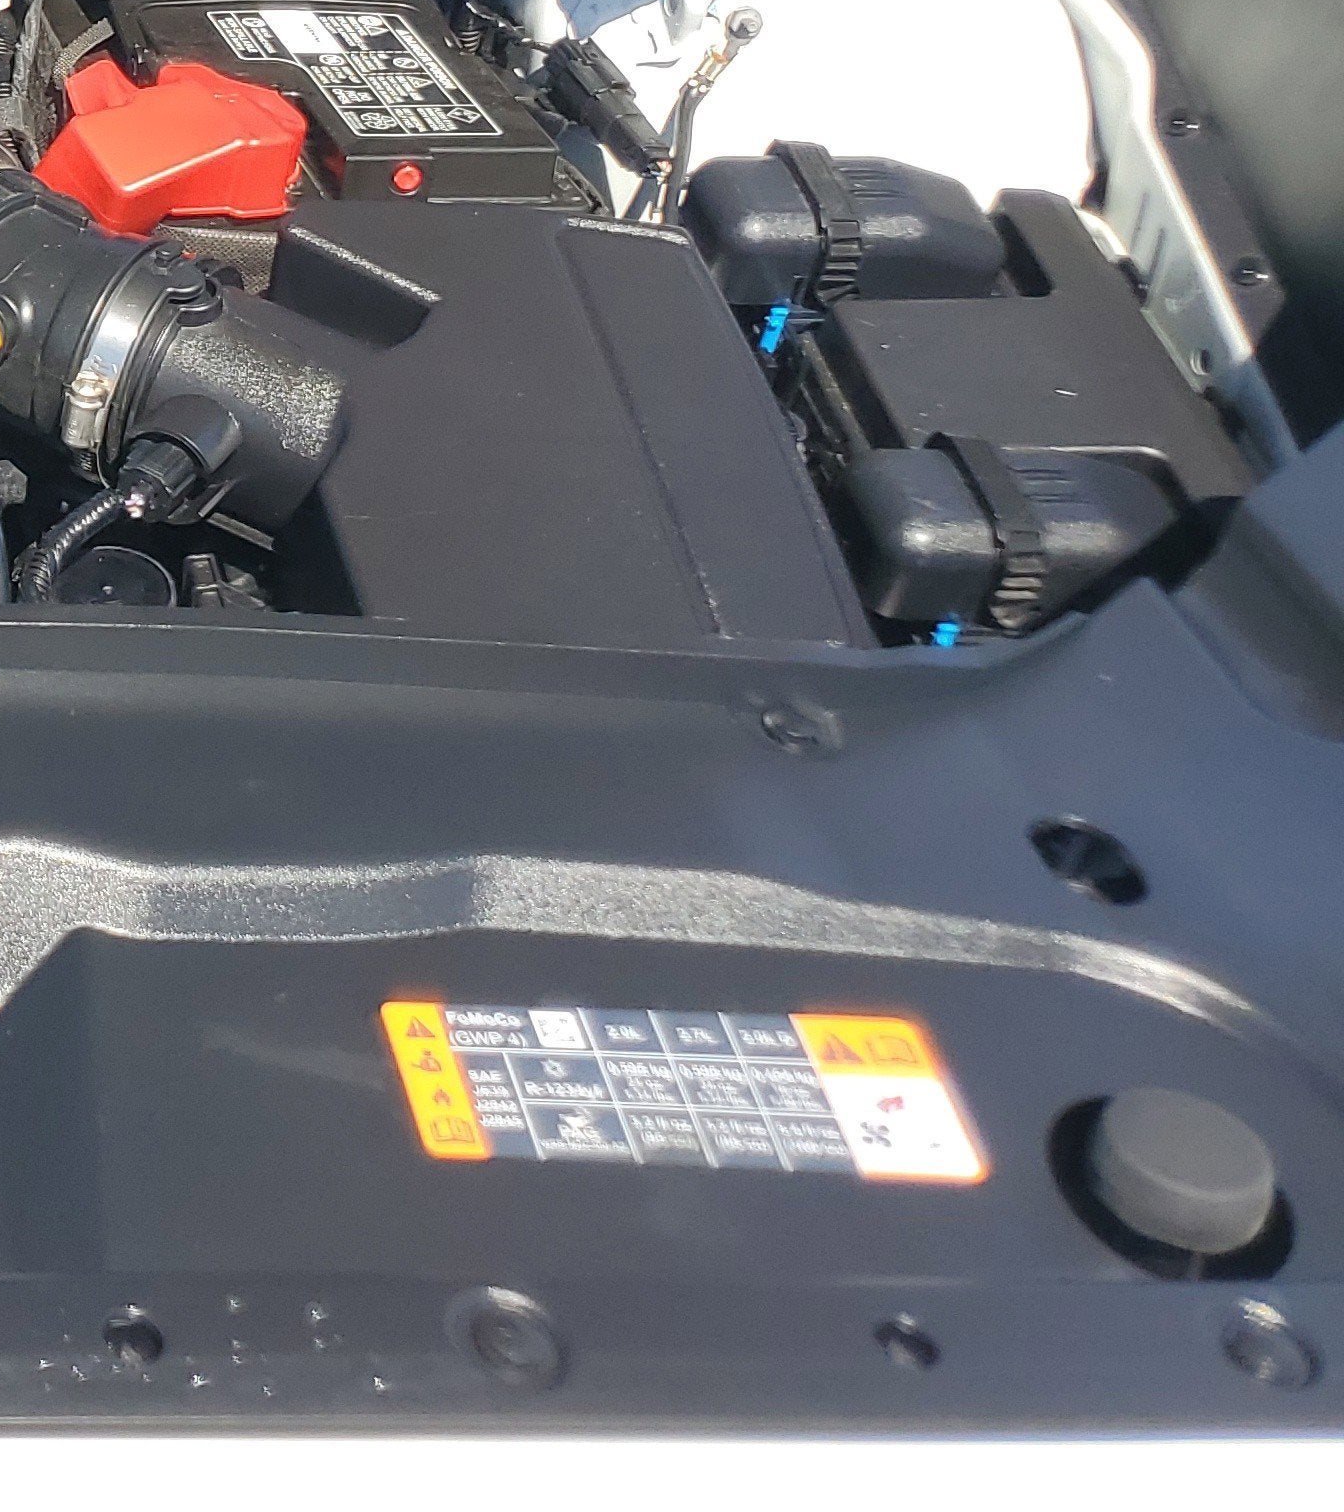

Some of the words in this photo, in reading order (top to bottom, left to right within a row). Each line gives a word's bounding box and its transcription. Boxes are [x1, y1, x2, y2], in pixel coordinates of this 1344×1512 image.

[445, 1010, 522, 1027] FoMoCo
[448, 1030, 504, 1046] (GWP
[468, 1069, 503, 1082] SAE
[474, 1085, 510, 1098] J639
